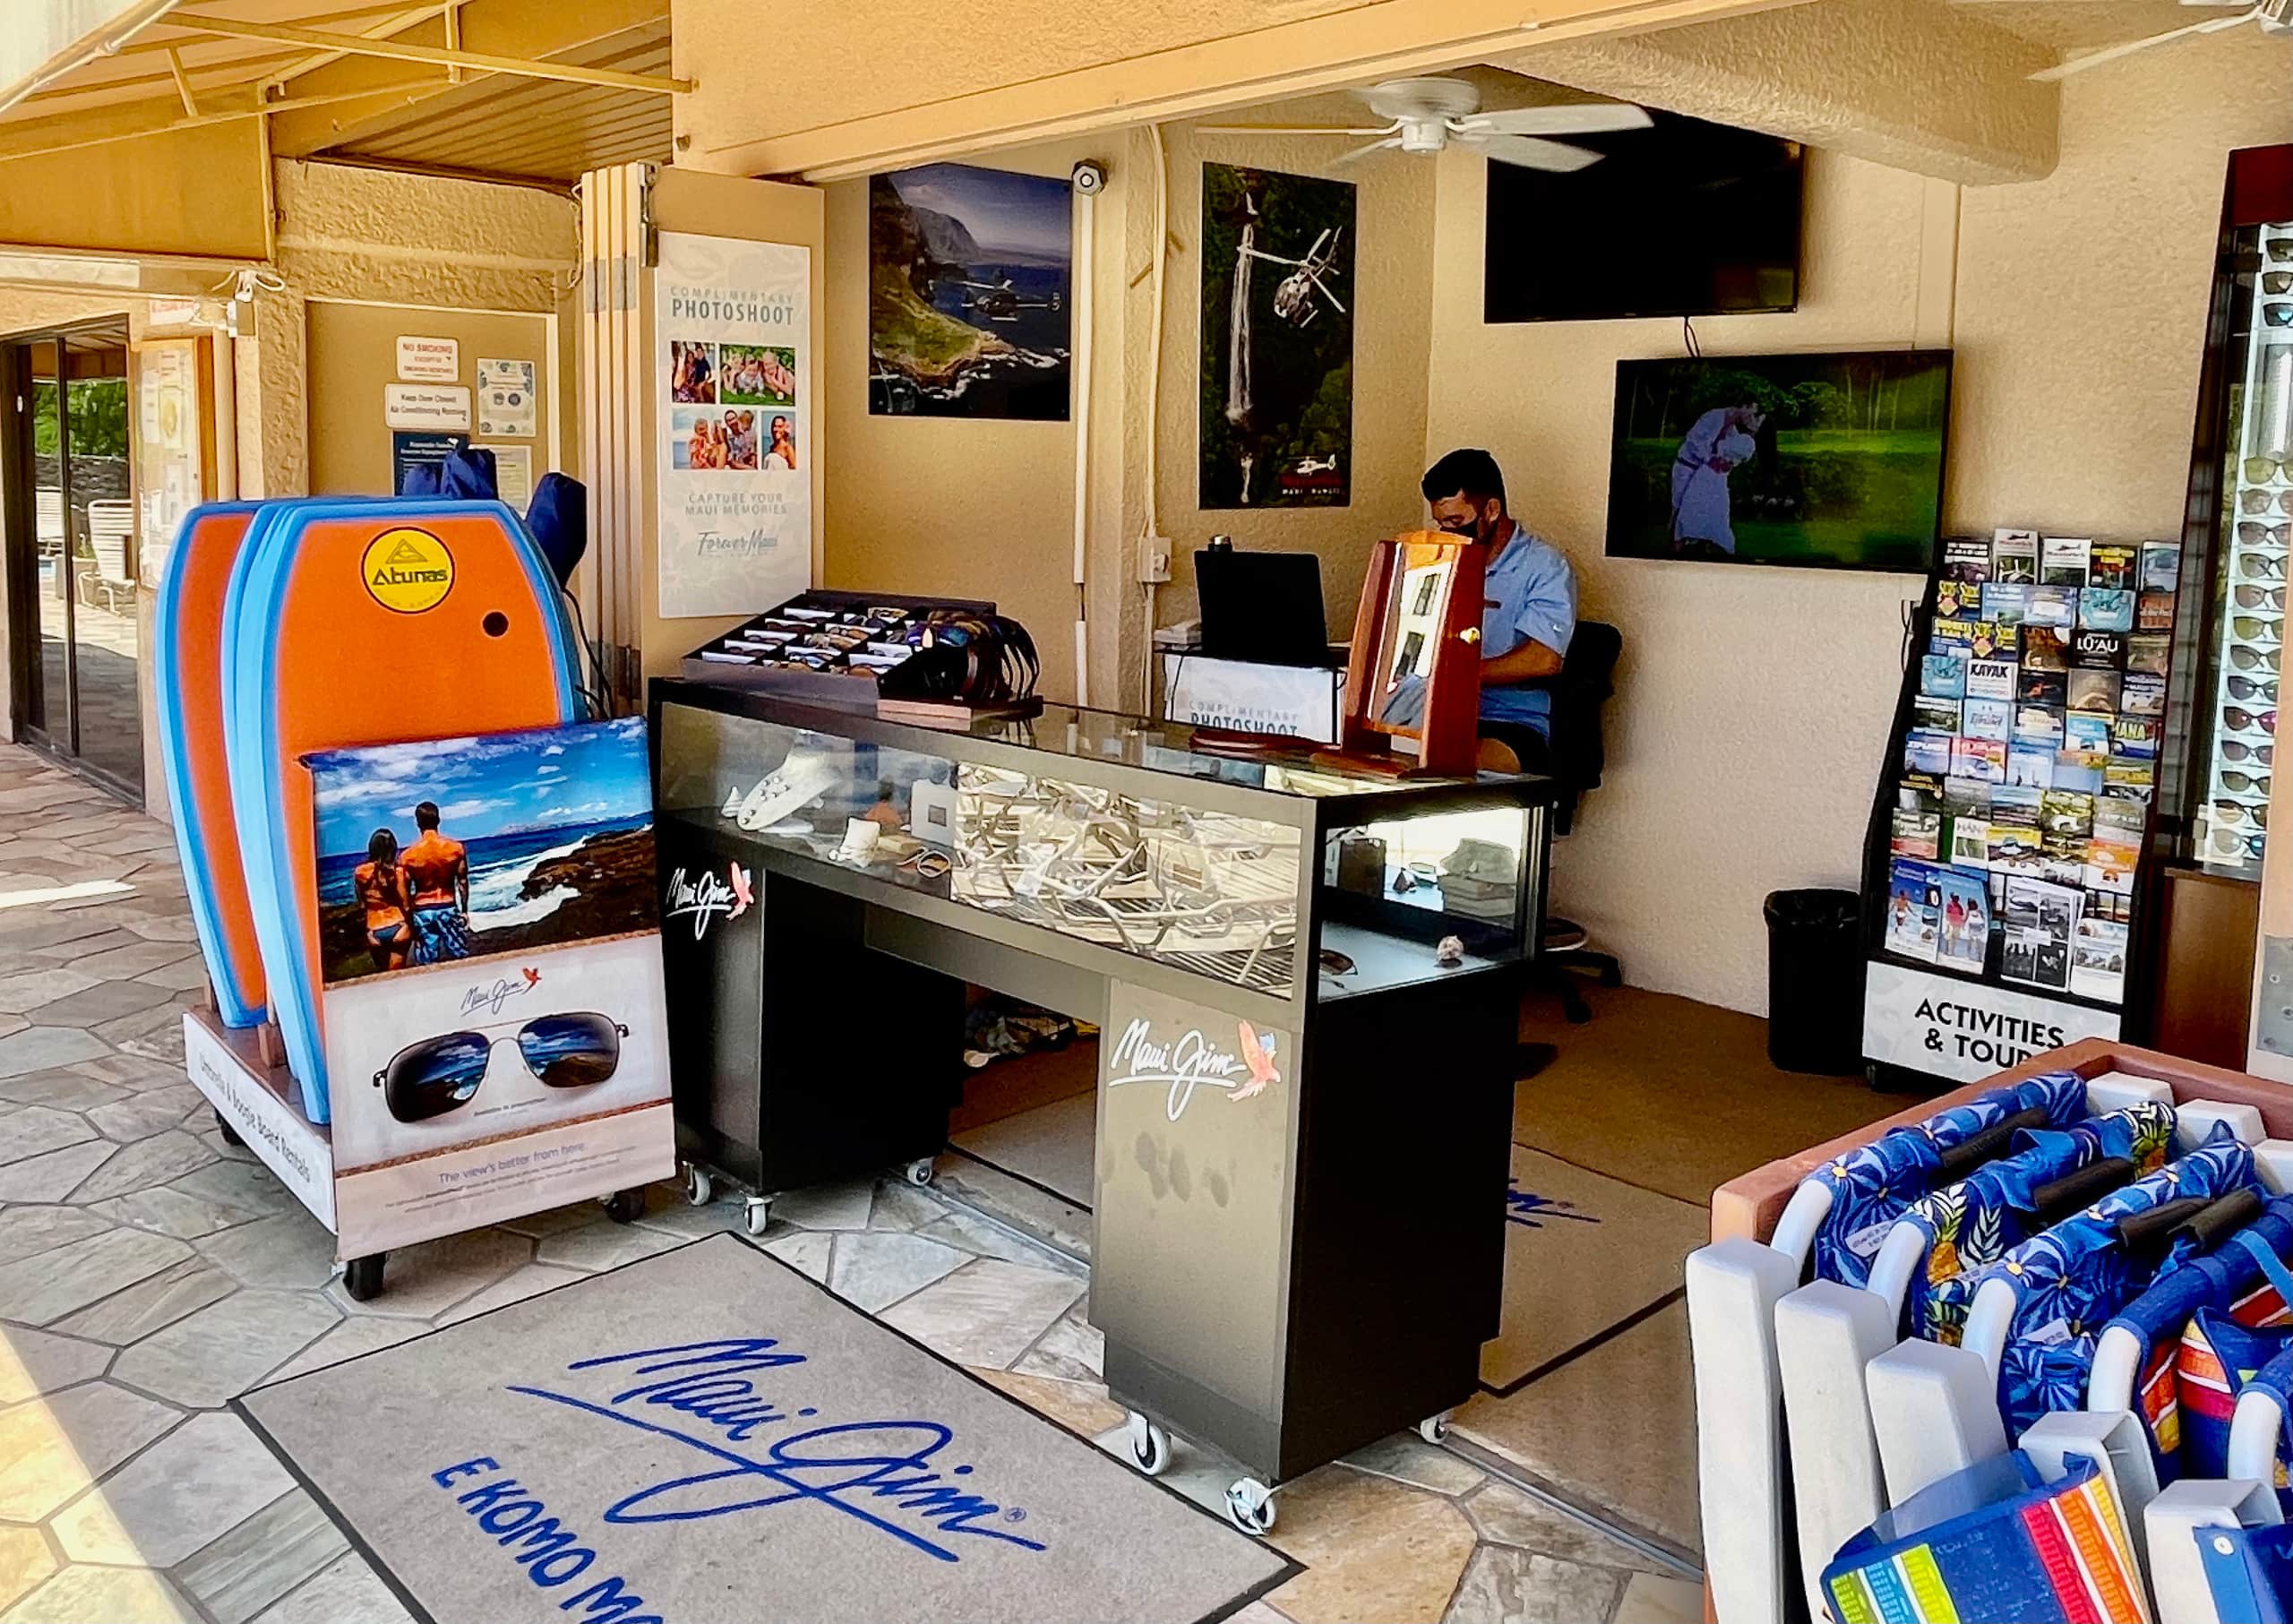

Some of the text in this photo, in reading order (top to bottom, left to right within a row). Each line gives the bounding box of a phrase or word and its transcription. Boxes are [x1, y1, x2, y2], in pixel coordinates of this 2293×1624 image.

[670, 287, 794, 305] COMPLIMENTARY
[672, 298, 794, 326] PHOTOSHOOT
[402, 343, 453, 355] NO SMOKING
[684, 504, 788, 517] MAUI MEMORIES
[689, 493, 784, 504] CAPTURE YOUR
[373, 566, 448, 586] Atunas
[1971, 664, 2008, 678] KAYAK
[1189, 700, 1299, 721] COMPLIMENTARY
[665, 866, 736, 941] Maui Jim
[1914, 997, 2065, 1049] ACTIVITIES
[1924, 1027, 1944, 1053] &
[1110, 1018, 1248, 1121] Maui Jim
[438, 1172, 460, 1184] The
[462, 1162, 495, 1180] view's
[497, 1155, 530, 1172] better
[533, 1147, 559, 1163] from
[567, 1338, 818, 1442] Maui
[431, 1456, 665, 1624] E KOMO M
